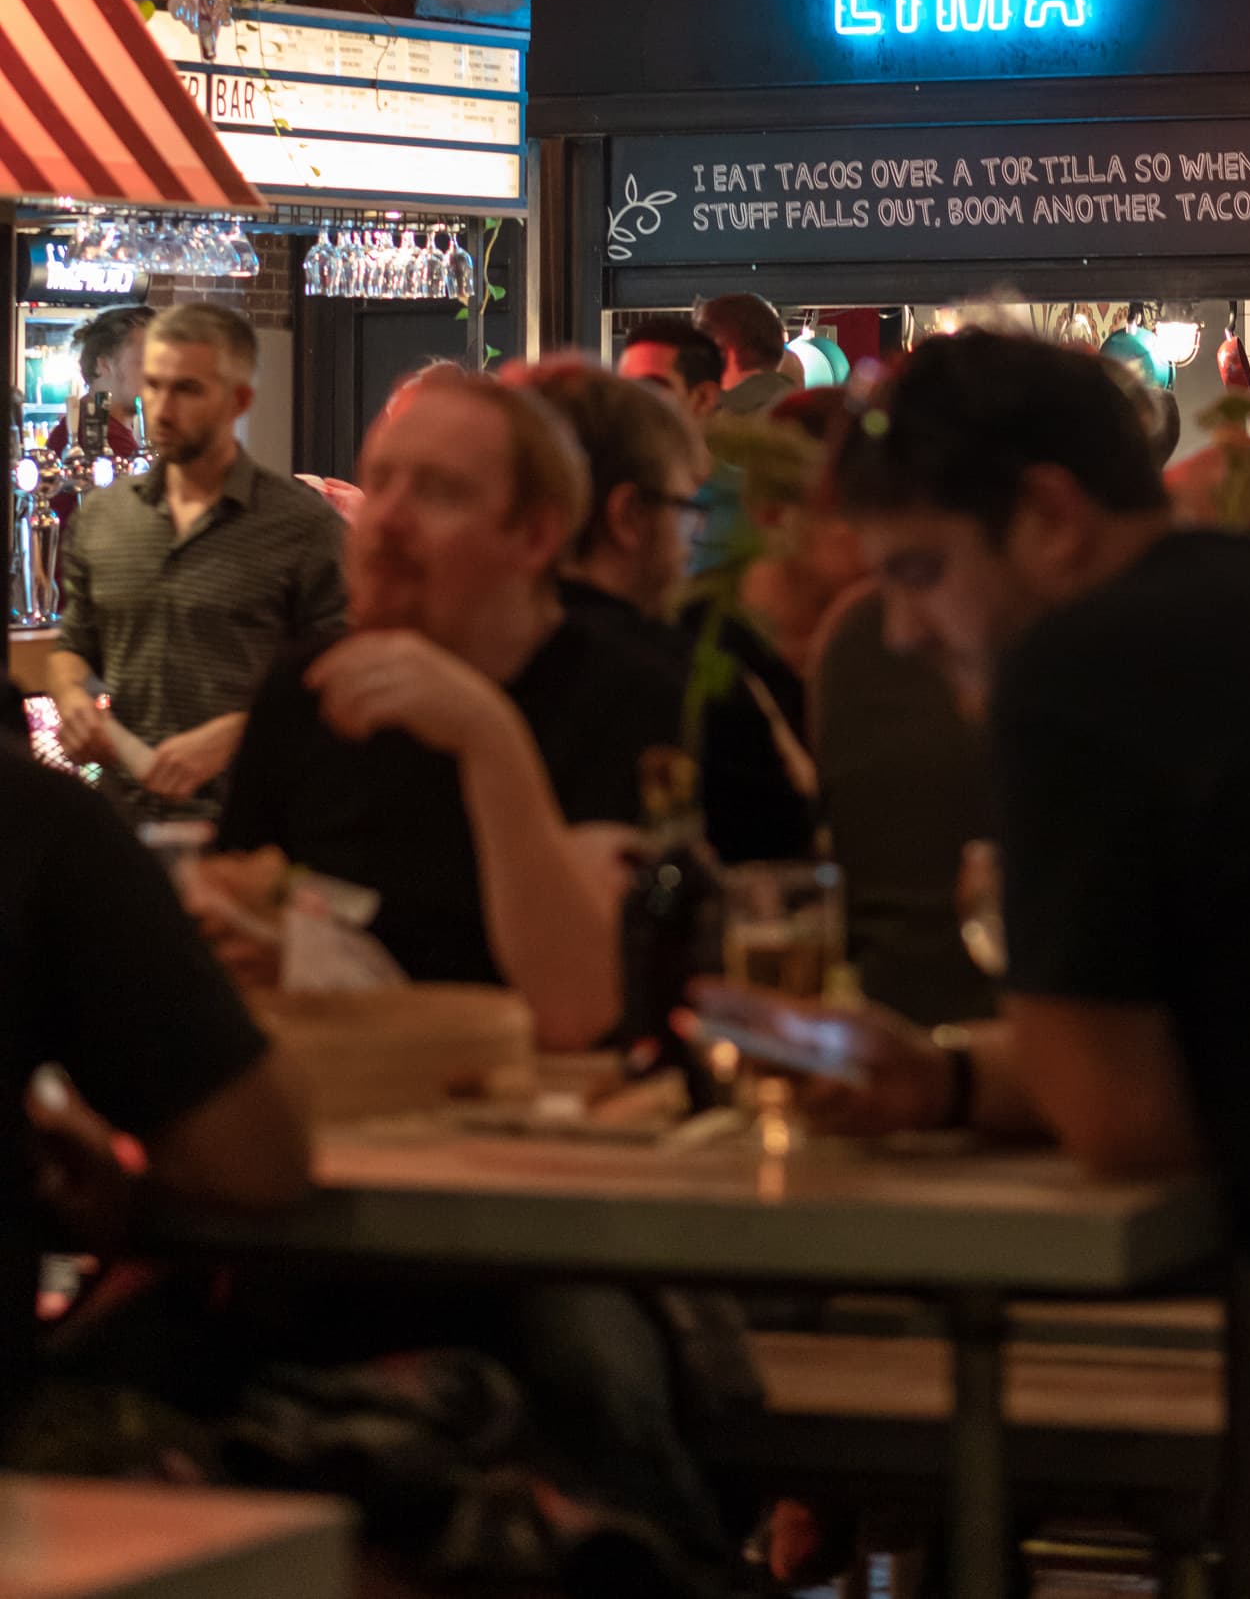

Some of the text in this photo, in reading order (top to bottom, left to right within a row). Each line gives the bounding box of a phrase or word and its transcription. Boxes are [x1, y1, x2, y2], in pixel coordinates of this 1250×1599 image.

[217, 79, 255, 119] BAR
[693, 164, 705, 192] I
[713, 163, 766, 192] EAT
[774, 161, 863, 191] TACOS
[871, 159, 944, 189] OVER
[953, 159, 972, 187] A
[980, 154, 1127, 186] TORTILLA
[1134, 153, 1171, 183] SO
[692, 201, 778, 231] STUFF
[785, 200, 869, 228] FALLS
[948, 193, 1024, 226] BOOM
[1033, 193, 1166, 225] ANOTHER
